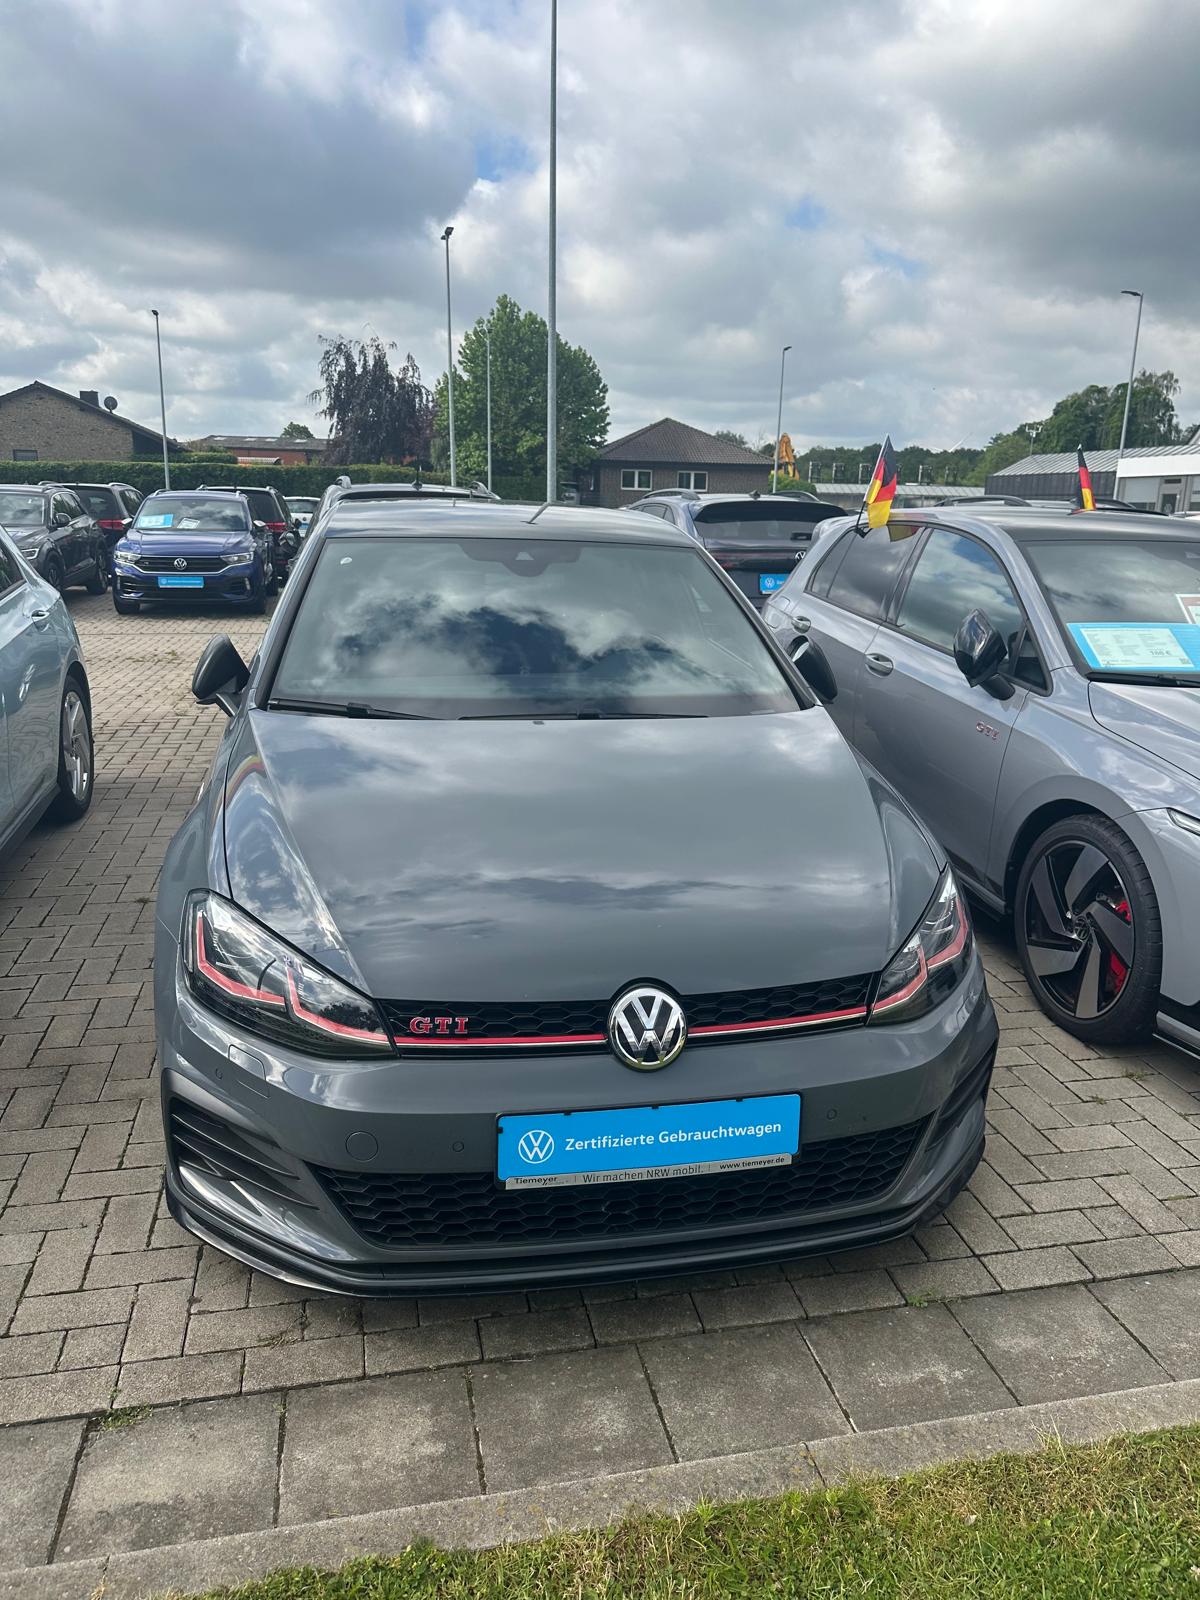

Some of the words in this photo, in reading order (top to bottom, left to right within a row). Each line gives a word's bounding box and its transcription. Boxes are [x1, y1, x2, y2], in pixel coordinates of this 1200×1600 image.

[976, 721, 999, 740] GTI
[409, 1016, 469, 1034] GTI
[608, 986, 687, 1071] VW
[565, 1134, 655, 1151] Zertifizierte
[658, 1123, 782, 1143] Gebrauchtwagen
[719, 1157, 785, 1170] www.tiemeyer.de
[515, 1177, 557, 1186] Tiemeyer
[583, 1174, 601, 1184] Wir
[603, 1170, 643, 1182] machen
[646, 1168, 670, 1179] NRW
[672, 1165, 704, 1176] mobil.
